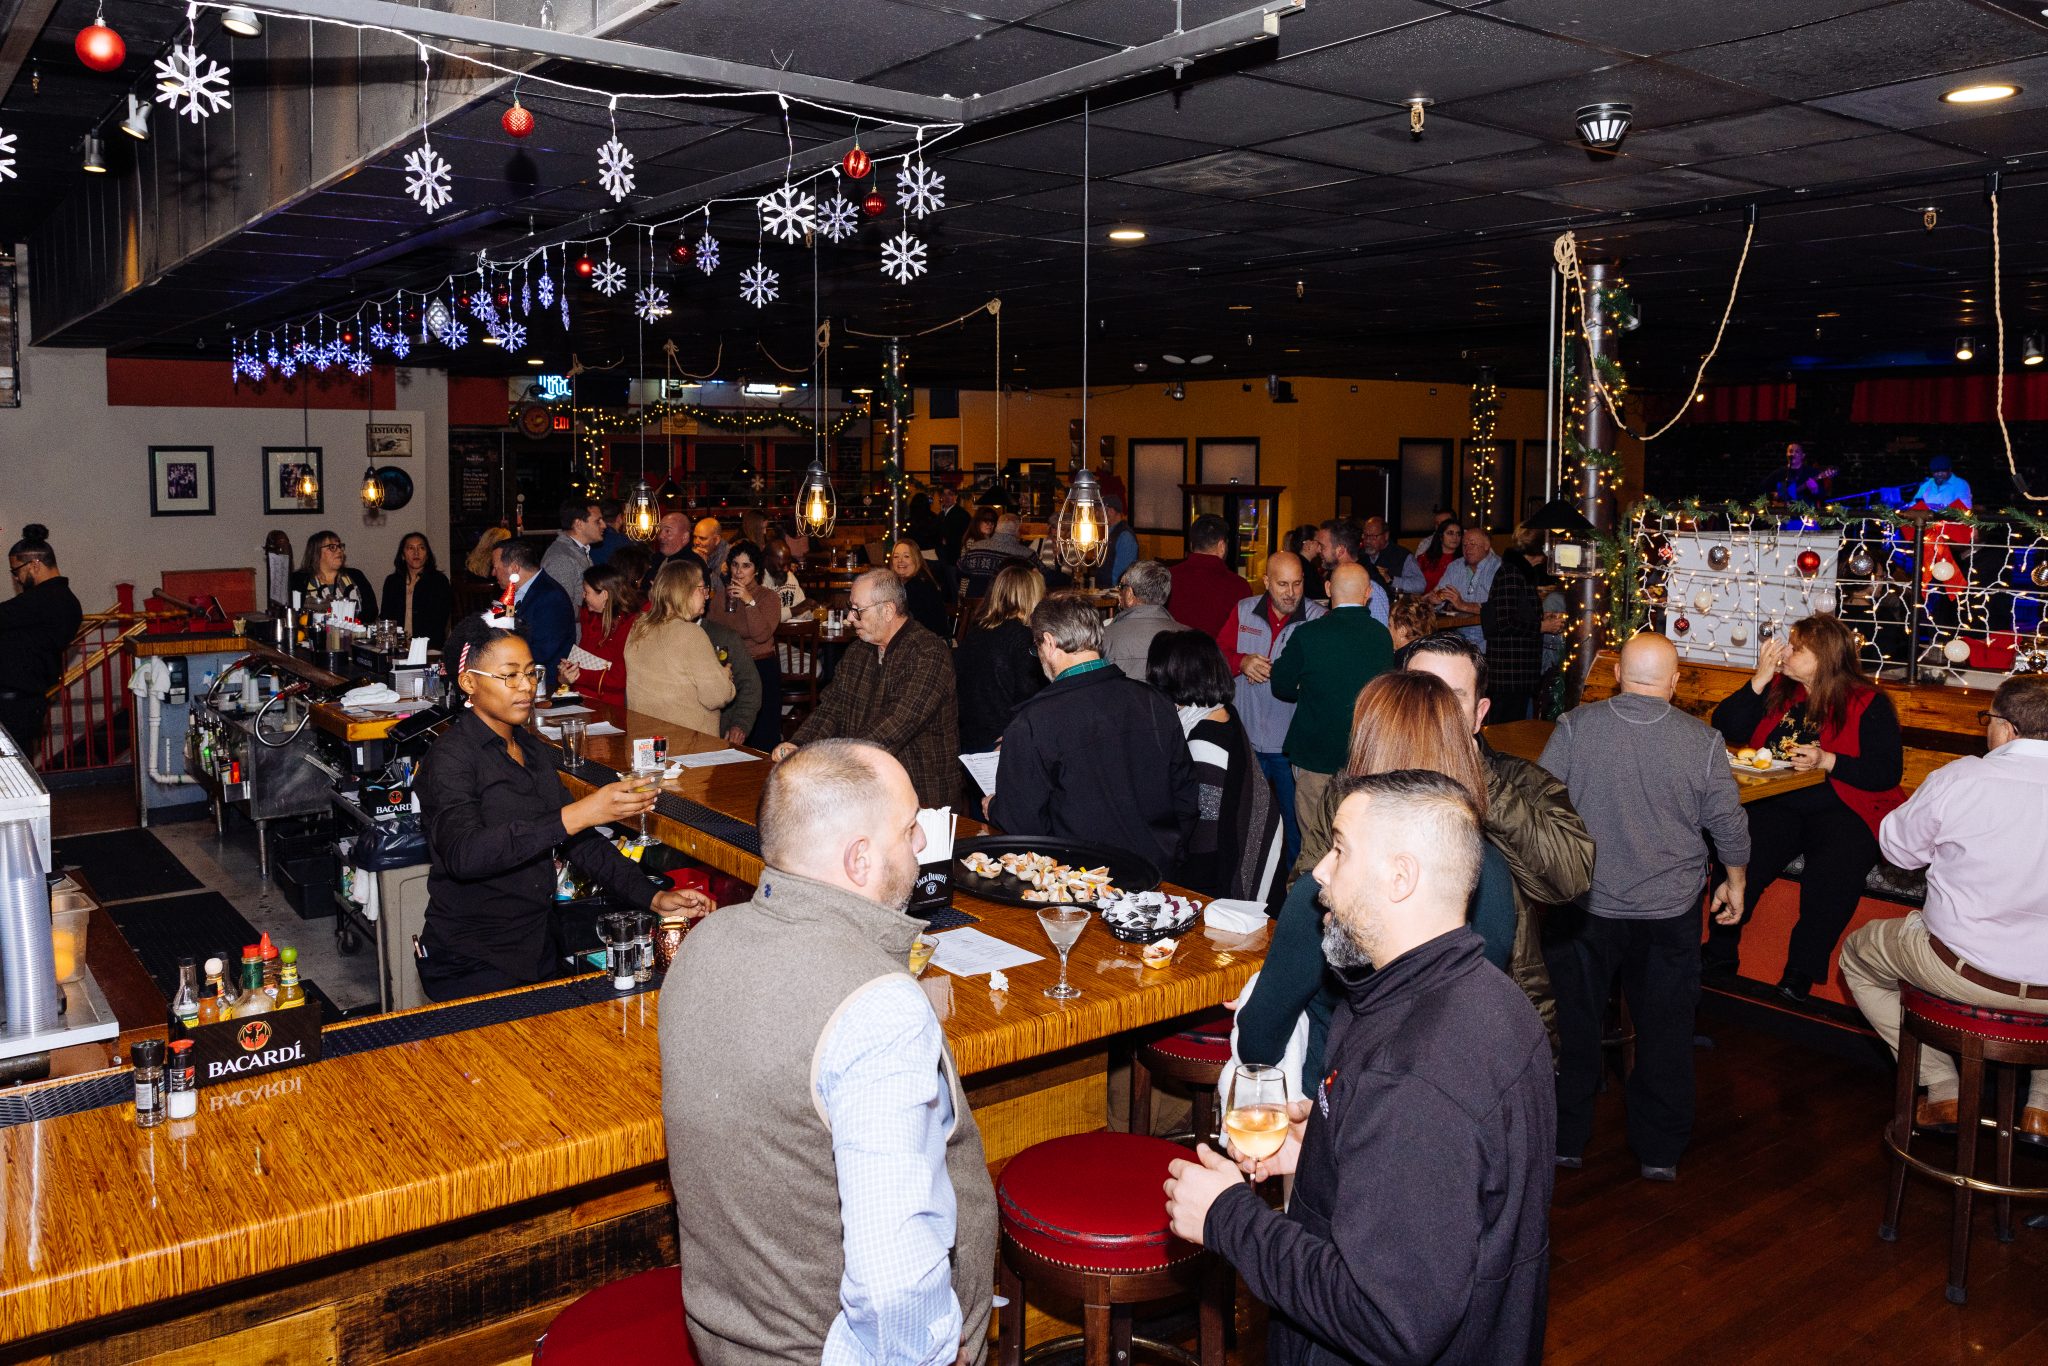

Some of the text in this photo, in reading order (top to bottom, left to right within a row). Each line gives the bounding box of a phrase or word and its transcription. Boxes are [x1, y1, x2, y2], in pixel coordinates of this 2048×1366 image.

[553, 416, 570, 429] EXIT
[376, 803, 412, 814] BACARD
[916, 875, 929, 888] JACK
[208, 1040, 302, 1078] BACARDÍ
